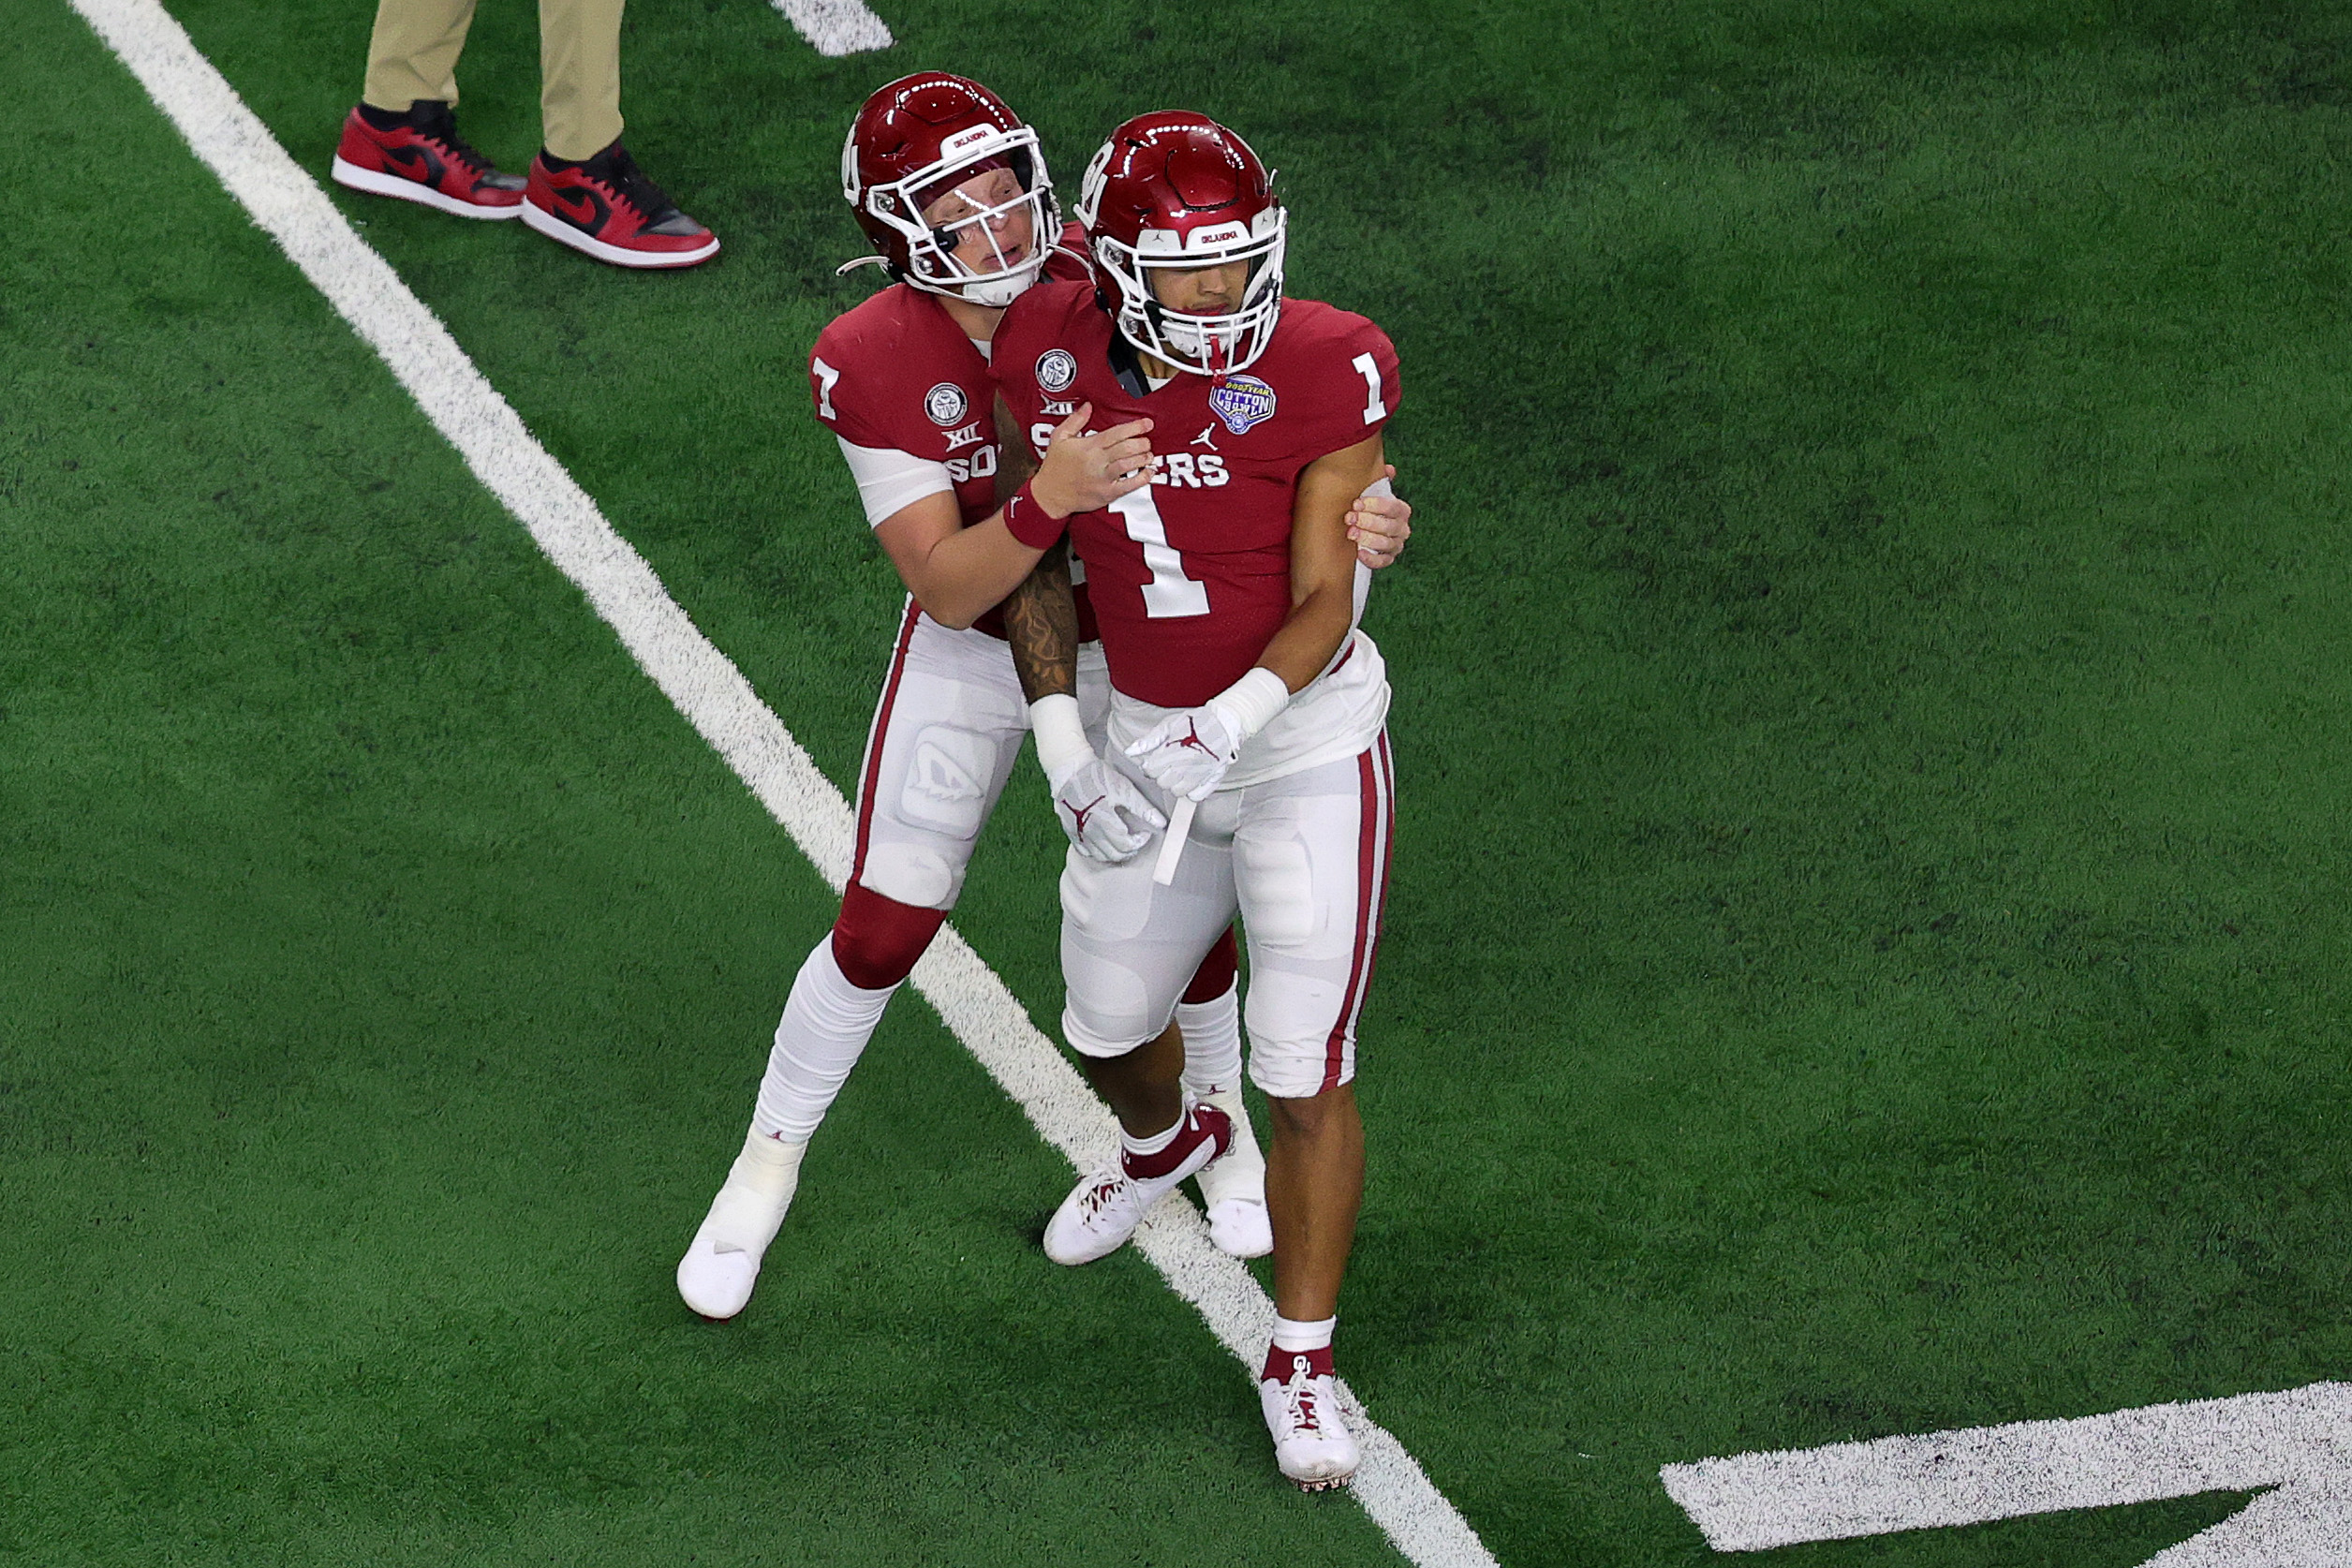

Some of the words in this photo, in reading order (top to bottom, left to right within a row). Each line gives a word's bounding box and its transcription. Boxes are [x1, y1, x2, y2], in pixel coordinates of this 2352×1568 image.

[812, 356, 839, 421] 7
[1216, 389, 1270, 414] COTTON
[1223, 400, 1258, 416] BOWL
[1352, 351, 1387, 425] 1
[1107, 482, 1211, 618] 1
